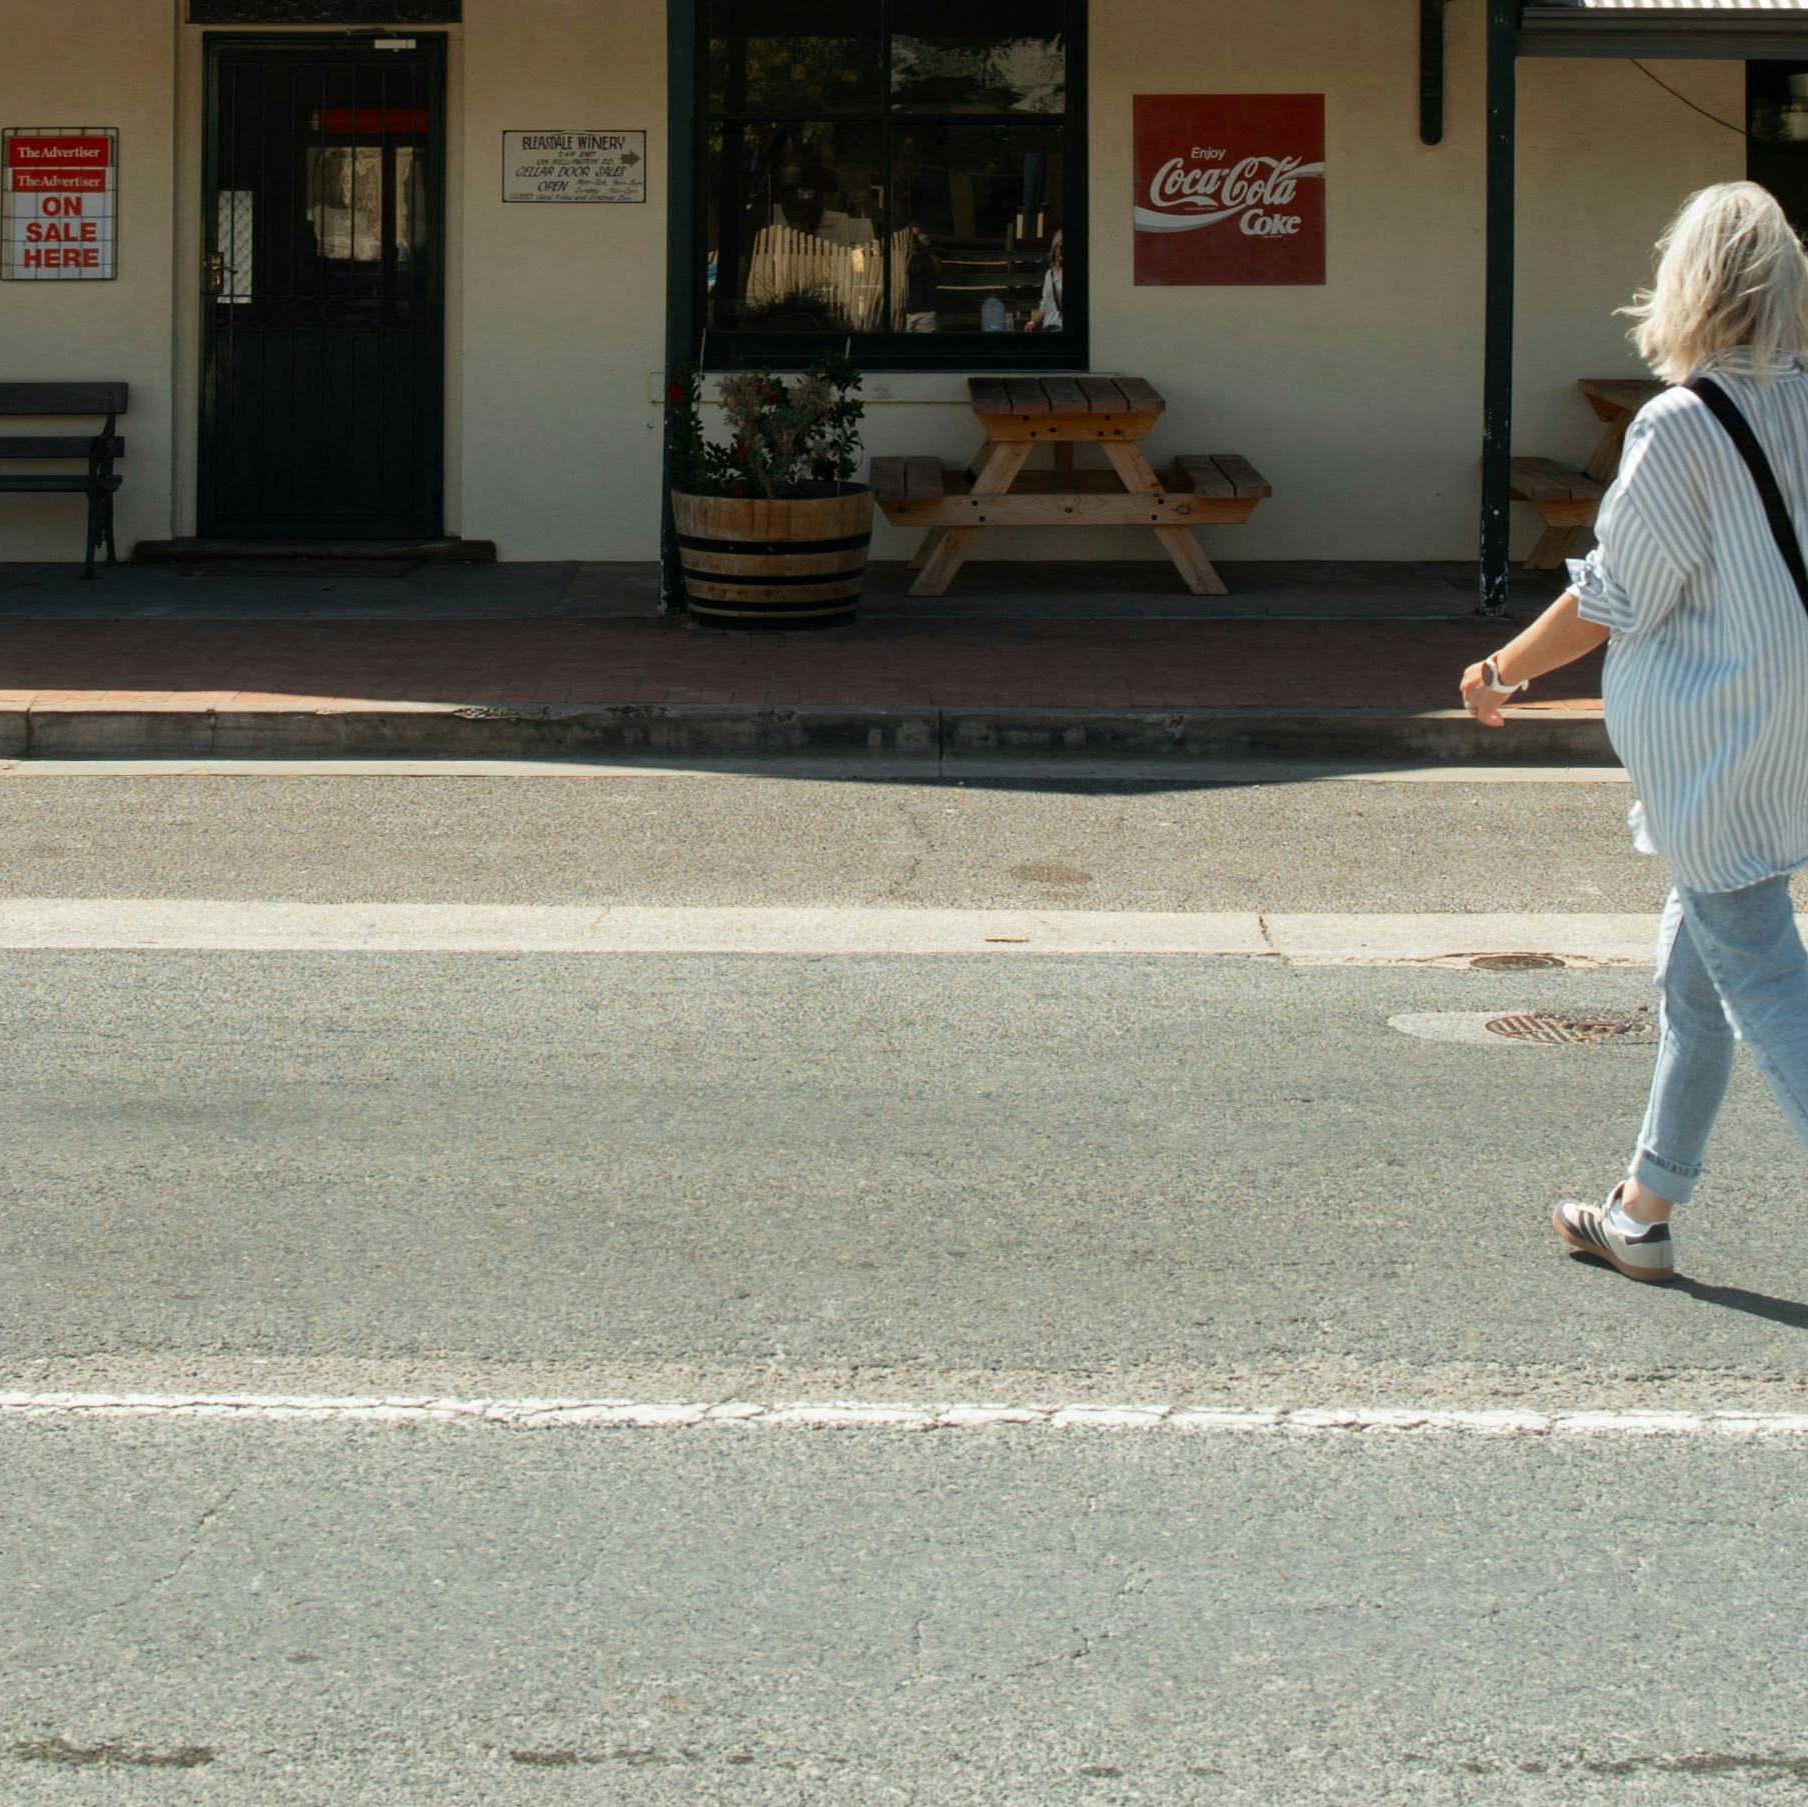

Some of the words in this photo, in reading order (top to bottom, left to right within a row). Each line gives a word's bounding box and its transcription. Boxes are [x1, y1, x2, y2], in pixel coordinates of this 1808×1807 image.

[522, 136, 573, 150] BLEASDALE
[577, 136, 626, 150] WINERY
[17, 146, 40, 159] The
[41, 146, 101, 159] Advertiser
[1191, 147, 1226, 161] Enjoy
[515, 166, 555, 177] CELLAR
[558, 166, 591, 177] DOOR
[595, 166, 627, 177] SALES
[17, 175, 40, 187] The
[41, 175, 101, 187] Advertiser
[537, 180, 570, 192] OPEN
[1150, 156, 1302, 207] Coca-Cola
[42, 196, 82, 217] ON
[1239, 208, 1302, 235] Coke
[26, 222, 97, 243] SALE
[23, 248, 99, 269] HERE
